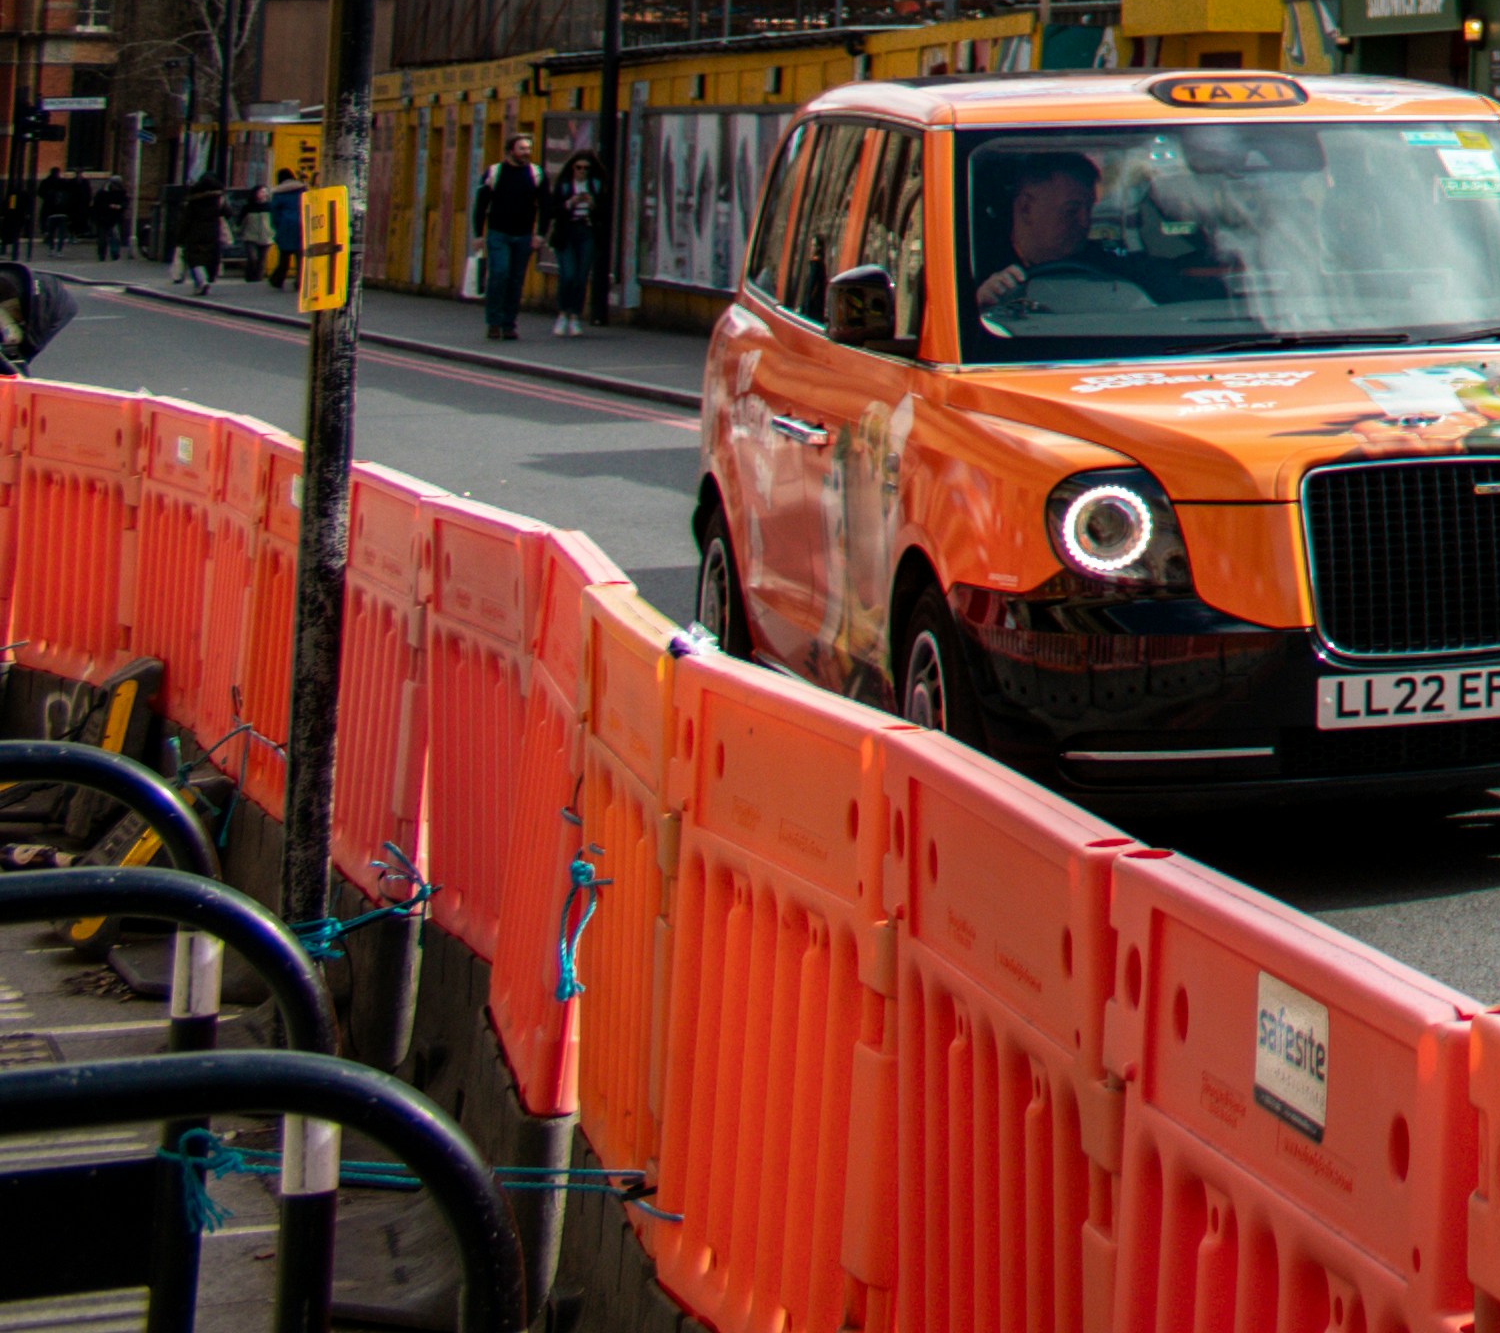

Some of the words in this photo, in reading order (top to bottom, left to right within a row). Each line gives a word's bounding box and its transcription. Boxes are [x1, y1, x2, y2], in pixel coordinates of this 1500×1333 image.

[1180, 83, 1286, 102] TAXI
[1335, 674, 1446, 719] LL22
[1258, 1006, 1326, 1082] safesite
